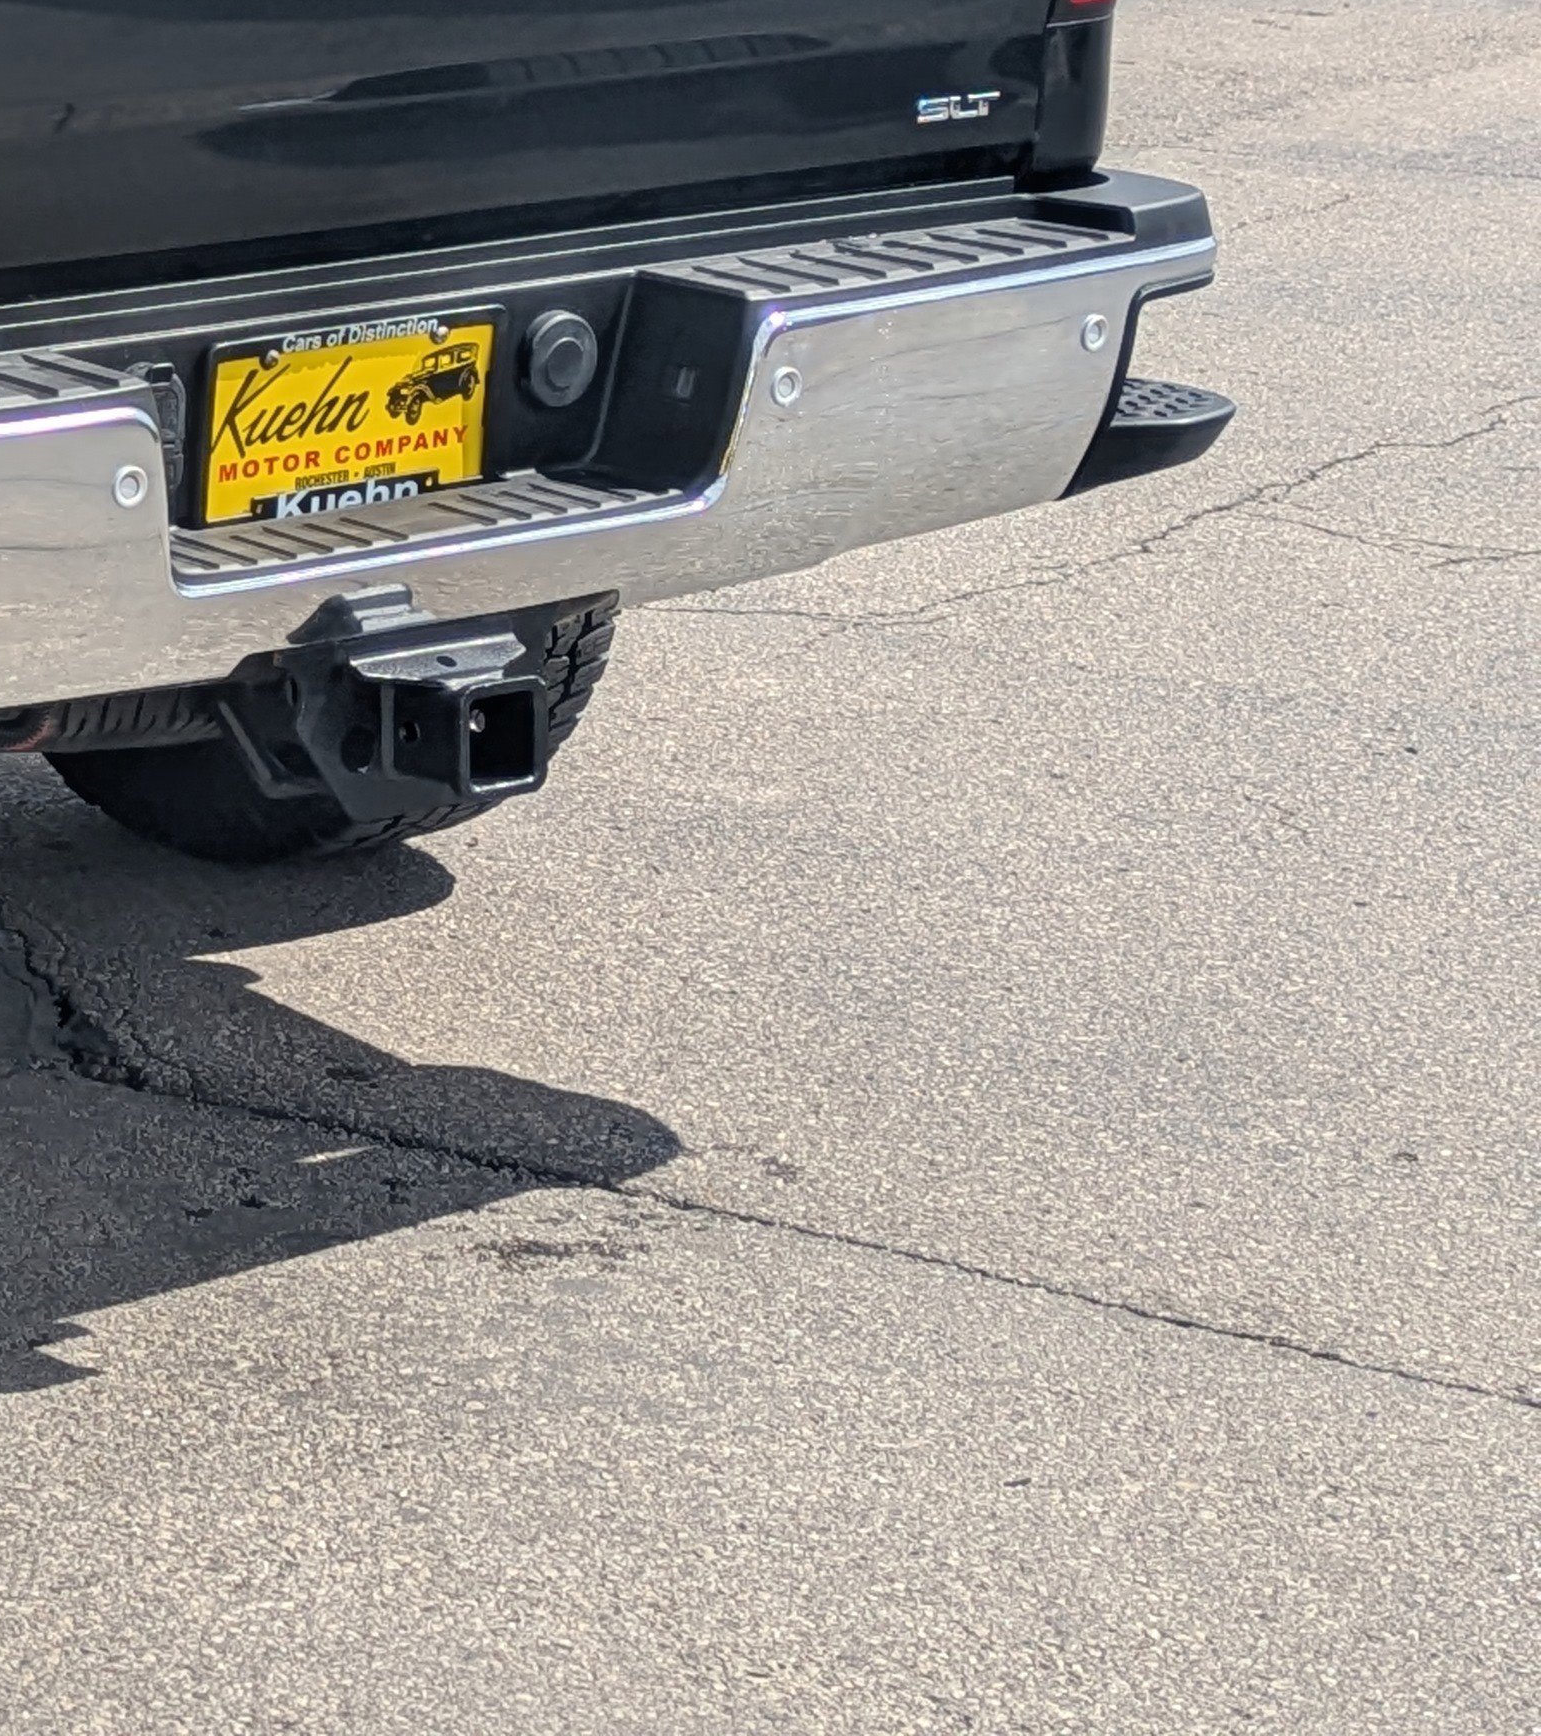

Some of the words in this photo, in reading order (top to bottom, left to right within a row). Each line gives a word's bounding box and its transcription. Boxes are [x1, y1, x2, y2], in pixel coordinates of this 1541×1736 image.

[917, 91, 1001, 123] SLT
[283, 334, 322, 353] Cars
[326, 329, 345, 347] of
[348, 317, 440, 345] Distinction
[209, 355, 371, 459] Kuehn
[219, 450, 320, 482] MOTOR
[334, 424, 469, 464] COMPANY
[295, 470, 349, 490] ROCHESTER
[364, 462, 396, 478] AUSTIN
[276, 478, 418, 519] Kuehn
